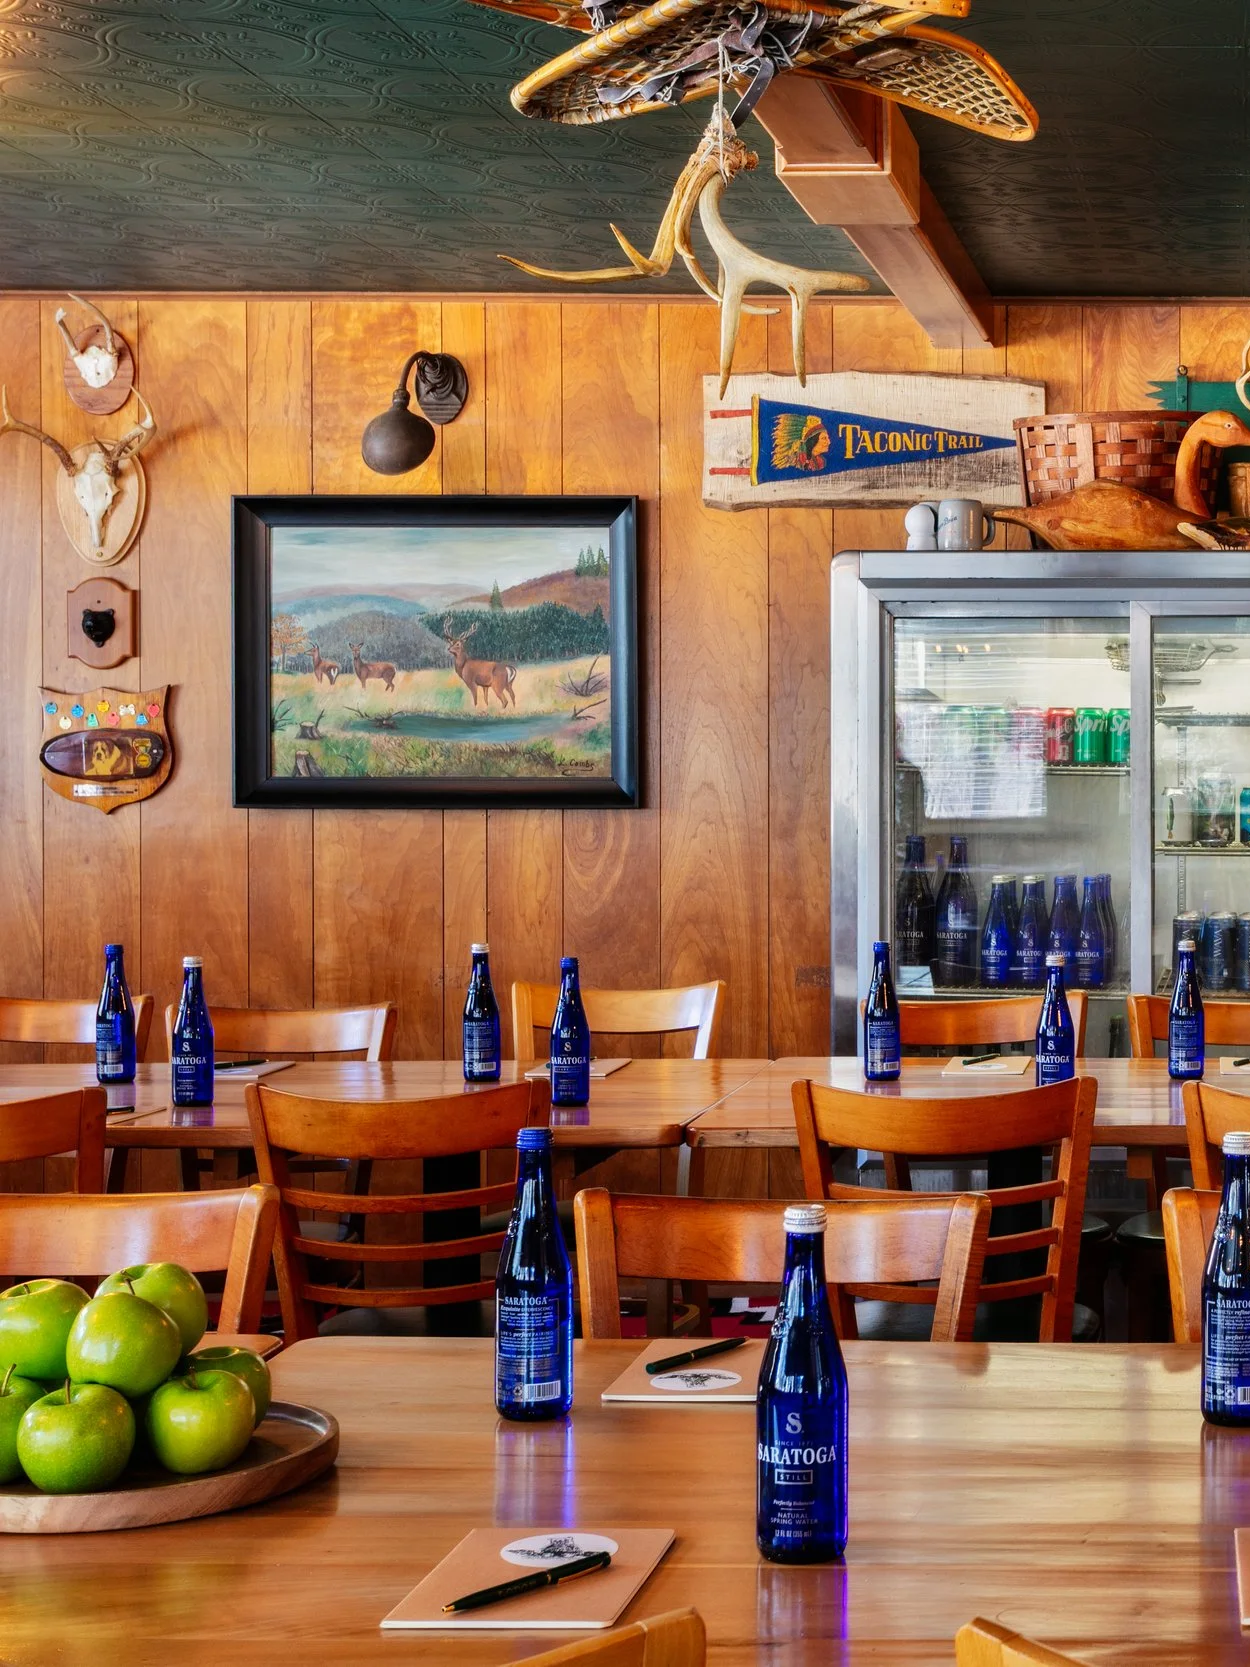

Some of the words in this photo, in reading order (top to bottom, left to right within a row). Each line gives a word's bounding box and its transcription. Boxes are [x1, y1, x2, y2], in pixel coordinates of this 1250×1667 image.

[838, 424, 932, 459] TACONIC
[934, 431, 984, 452] TRAIL
[1053, 939, 1060, 948] S
[1082, 940, 1088, 949] S
[1016, 949, 1041, 957] SARATOG
[182, 1041, 191, 1052] S
[564, 1041, 572, 1052] S
[1047, 1040, 1055, 1050] S
[172, 1056, 207, 1065] SARATOGA
[551, 1056, 587, 1065] SARATOGA
[1035, 1054, 1070, 1063] SARATOGA
[504, 1296, 548, 1306] SARATOGA
[785, 1412, 802, 1434] S
[758, 1442, 837, 1465] SARATOGA
[780, 1473, 807, 1481] STILL
[771, 1517, 793, 1525] SPRING
